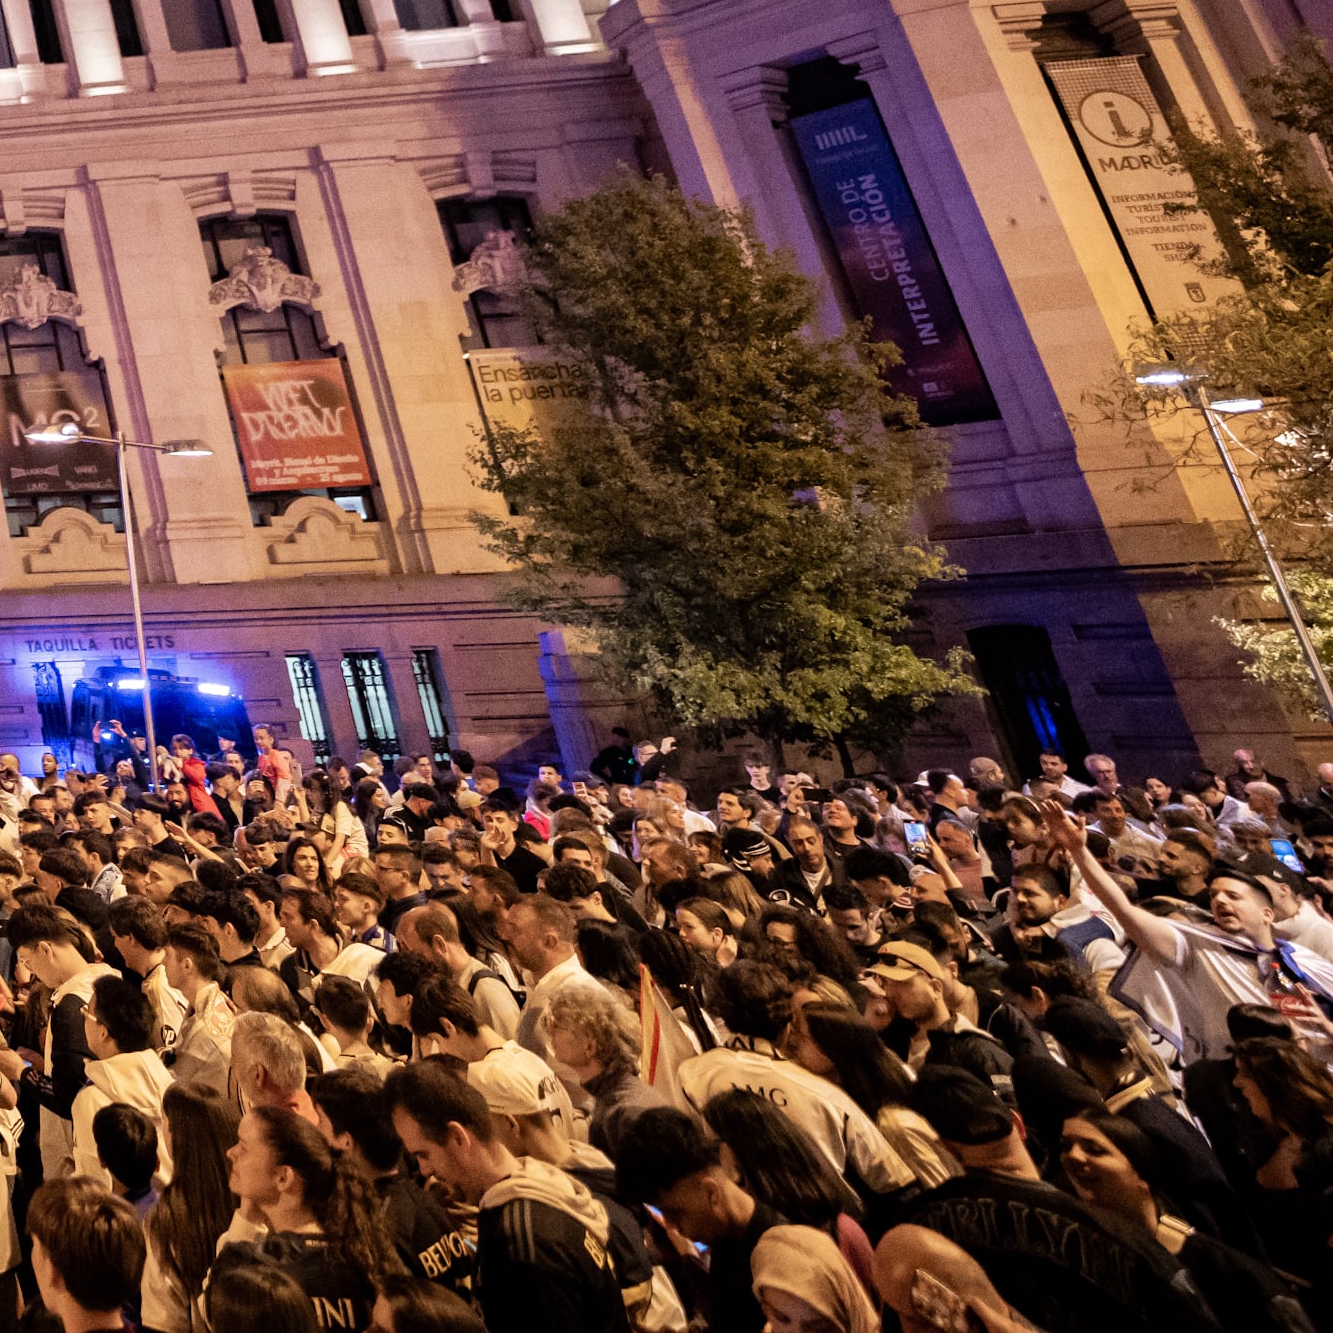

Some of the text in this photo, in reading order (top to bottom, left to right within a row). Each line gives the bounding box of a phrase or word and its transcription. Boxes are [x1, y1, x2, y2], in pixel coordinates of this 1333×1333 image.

[836, 178, 861, 205] DE
[1126, 223, 1207, 236] INFORMATION
[848, 208, 890, 282] CENTRO
[482, 385, 503, 403] la
[25, 635, 176, 653] TAQUILLA TICETS
